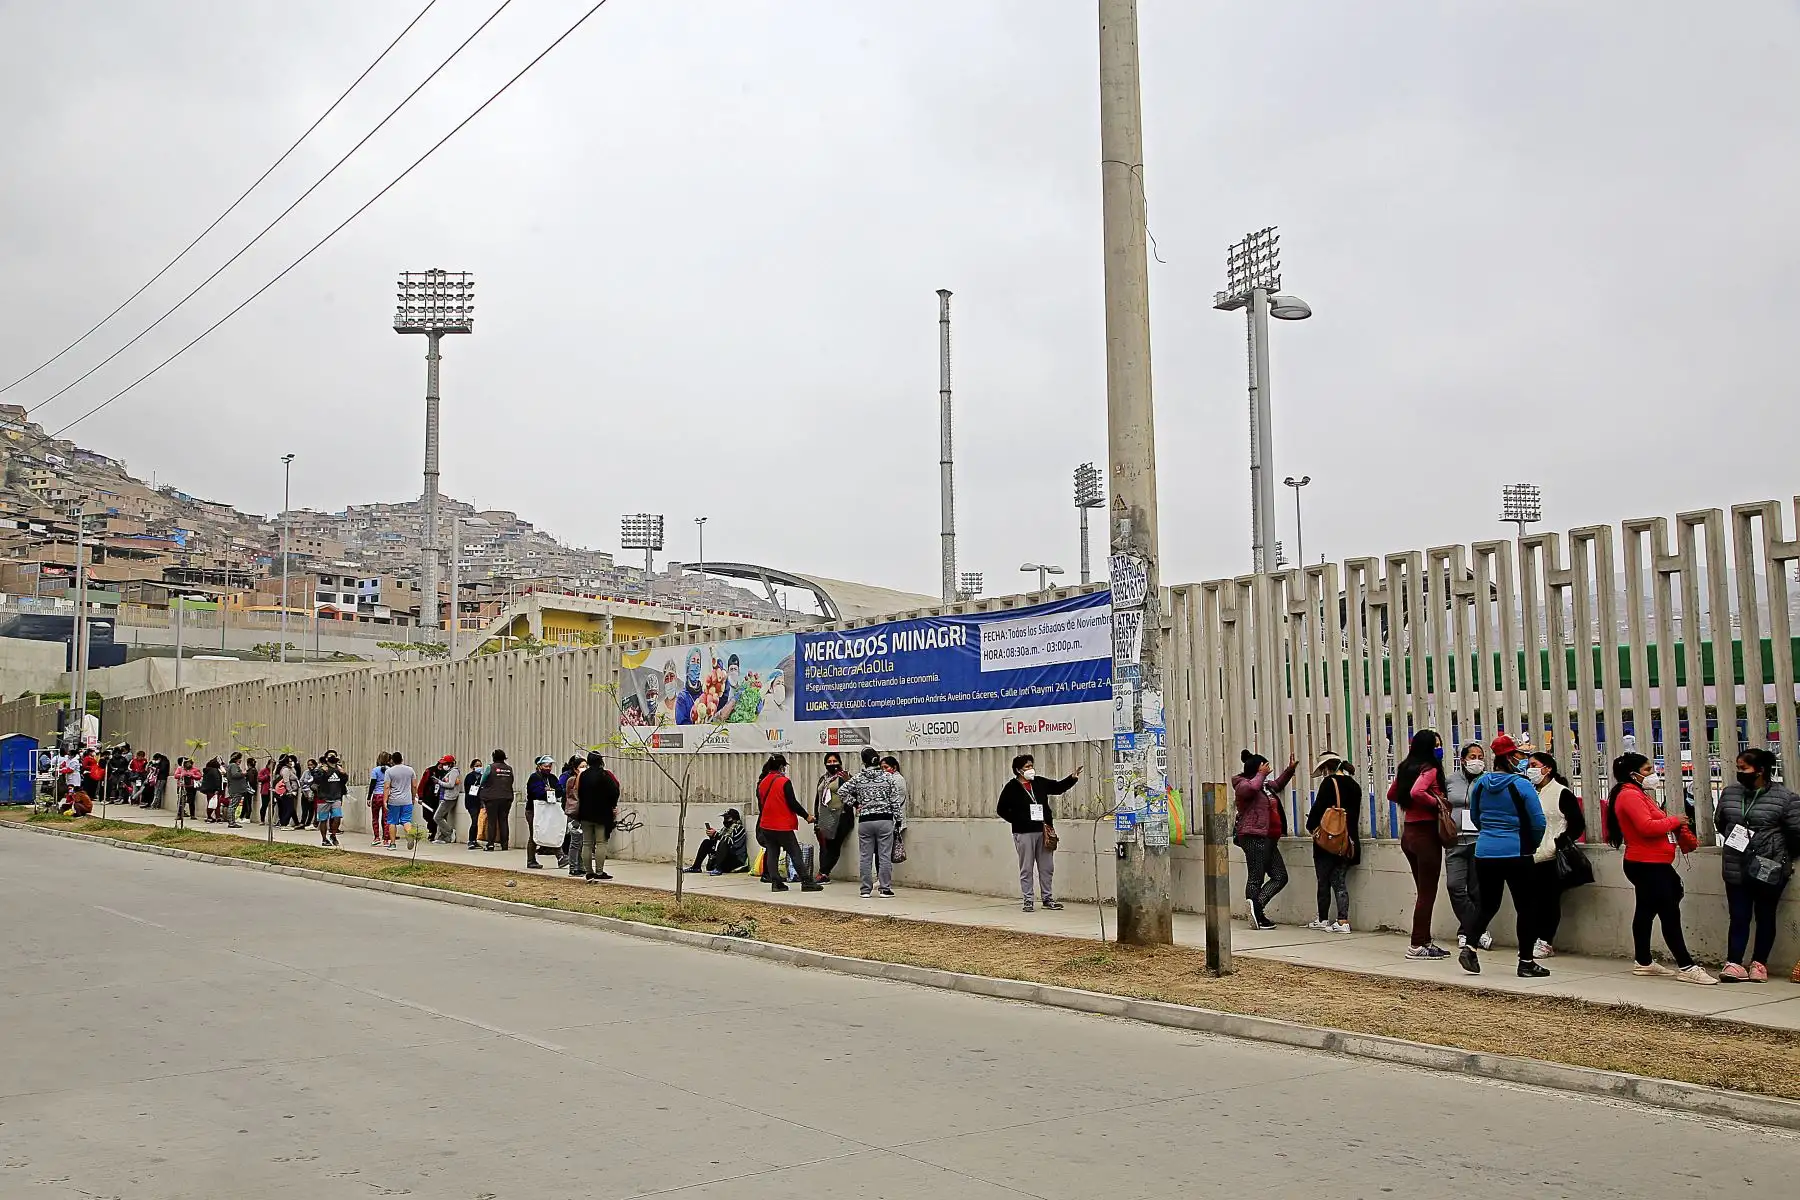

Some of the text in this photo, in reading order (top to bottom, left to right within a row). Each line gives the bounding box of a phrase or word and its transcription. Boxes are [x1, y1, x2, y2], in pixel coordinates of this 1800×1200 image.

[1027, 625, 1037, 637] los
[1038, 622, 1066, 635] Sábados
[1066, 619, 1076, 630] de
[1076, 614, 1113, 629] Noviembre
[804, 625, 967, 662] MERCADOS MINAGRI
[805, 659, 894, 679] #DelaChacraAlaOlla
[858, 676, 899, 689] reactivando
[899, 675, 906, 685] la
[906, 672, 940, 684] economía.
[806, 700, 829, 712] LUGAR:
[867, 697, 896, 709] Complejo
[896, 695, 925, 707] Deportivo
[925, 692, 947, 703] Andrés
[947, 690, 971, 701] Avelino
[972, 689, 1000, 700] Cáceres,
[1000, 687, 1018, 698] Calle
[1031, 683, 1054, 696] Raymi
[1071, 679, 1096, 691] Puerta
[1097, 677, 1112, 688] 2-A
[765, 729, 784, 741] VMT
